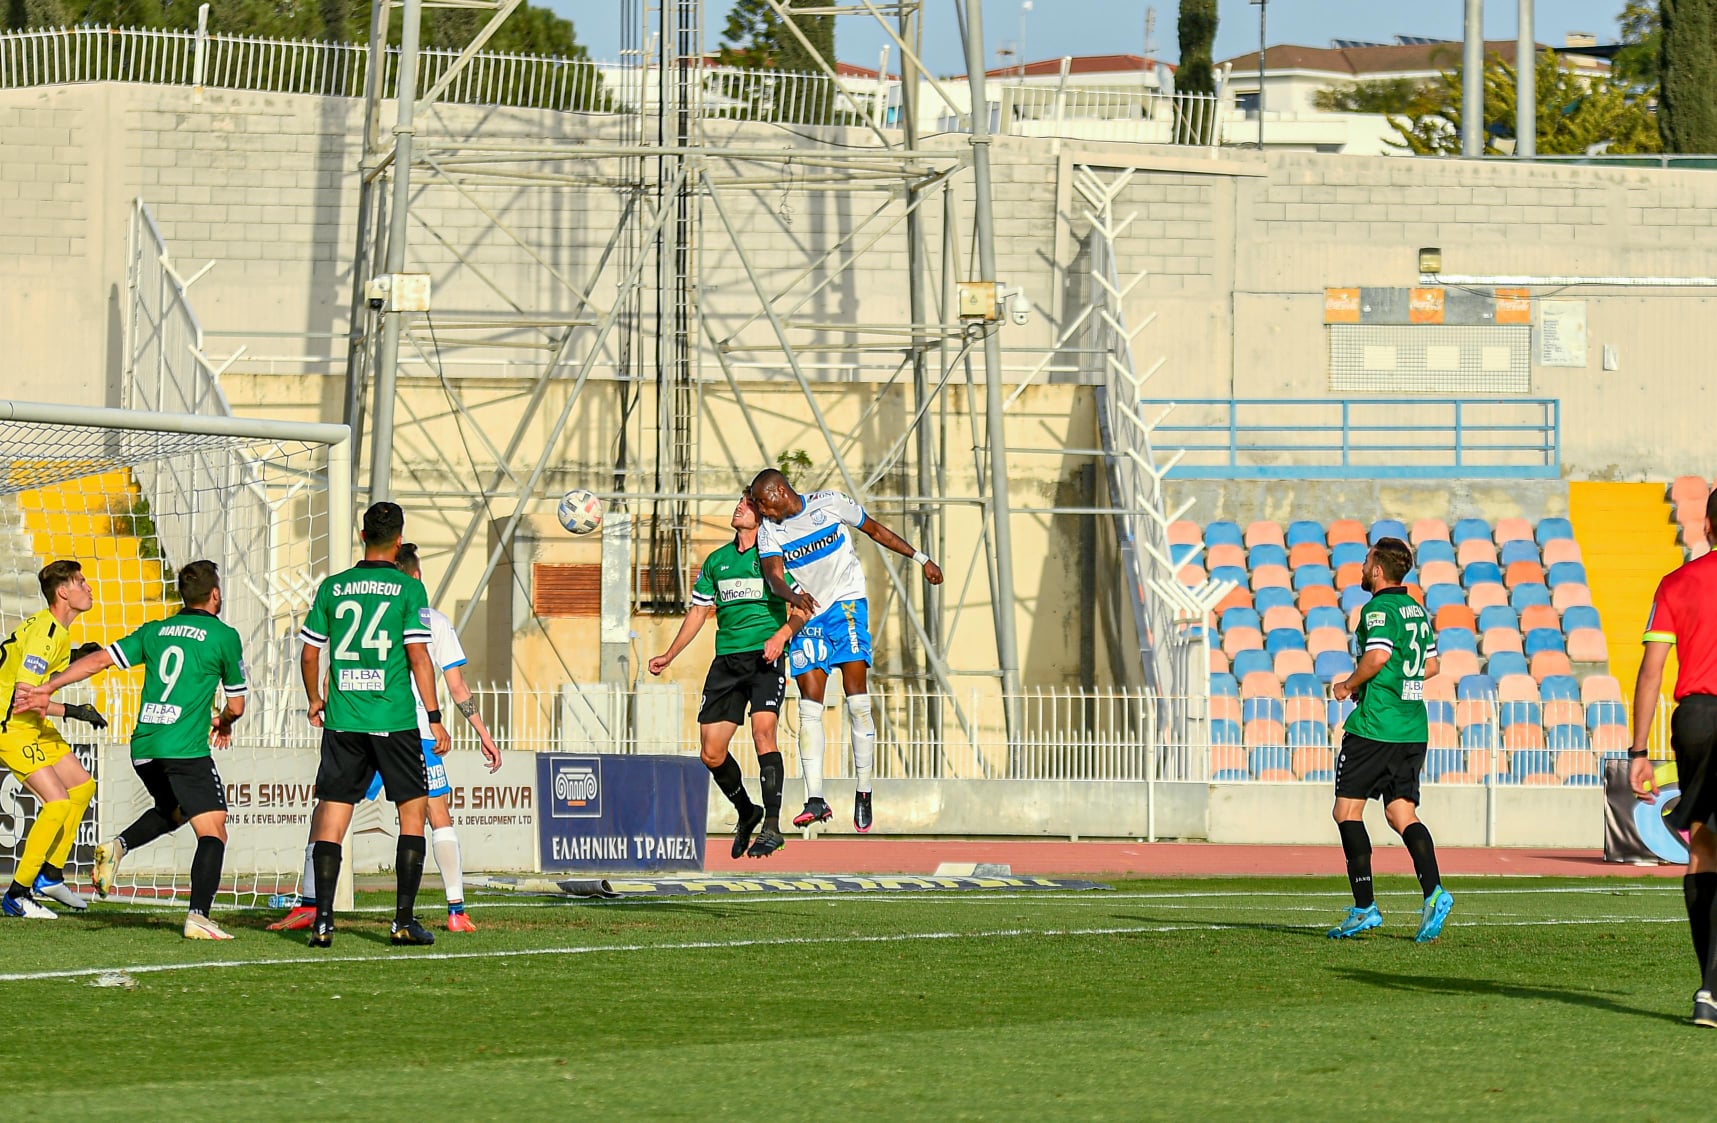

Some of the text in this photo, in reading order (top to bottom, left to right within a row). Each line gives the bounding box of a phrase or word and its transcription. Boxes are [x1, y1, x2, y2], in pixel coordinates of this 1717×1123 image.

[332, 580, 402, 597] S.ANDREOU
[721, 587, 762, 601] OfficePro
[158, 625, 207, 642] MANTZIS
[334, 600, 393, 661] 24
[1402, 621, 1430, 678] 32
[158, 645, 185, 703] 9
[341, 670, 382, 680] FI.BA
[340, 682, 382, 690] FILTER
[145, 703, 176, 715] FI.BA
[142, 714, 176, 723] FILTER
[22, 743, 46, 765] 93
[471, 786, 532, 809] SAVVA
[252, 814, 308, 825] DEVELOPMENT
[457, 816, 463, 825] &
[465, 816, 516, 825] DEVELOPMENT
[518, 816, 532, 825] LTD
[552, 835, 698, 860] ΕΛΛΗΝΙΚΗ ΤΡΑΠΕΖΑ
